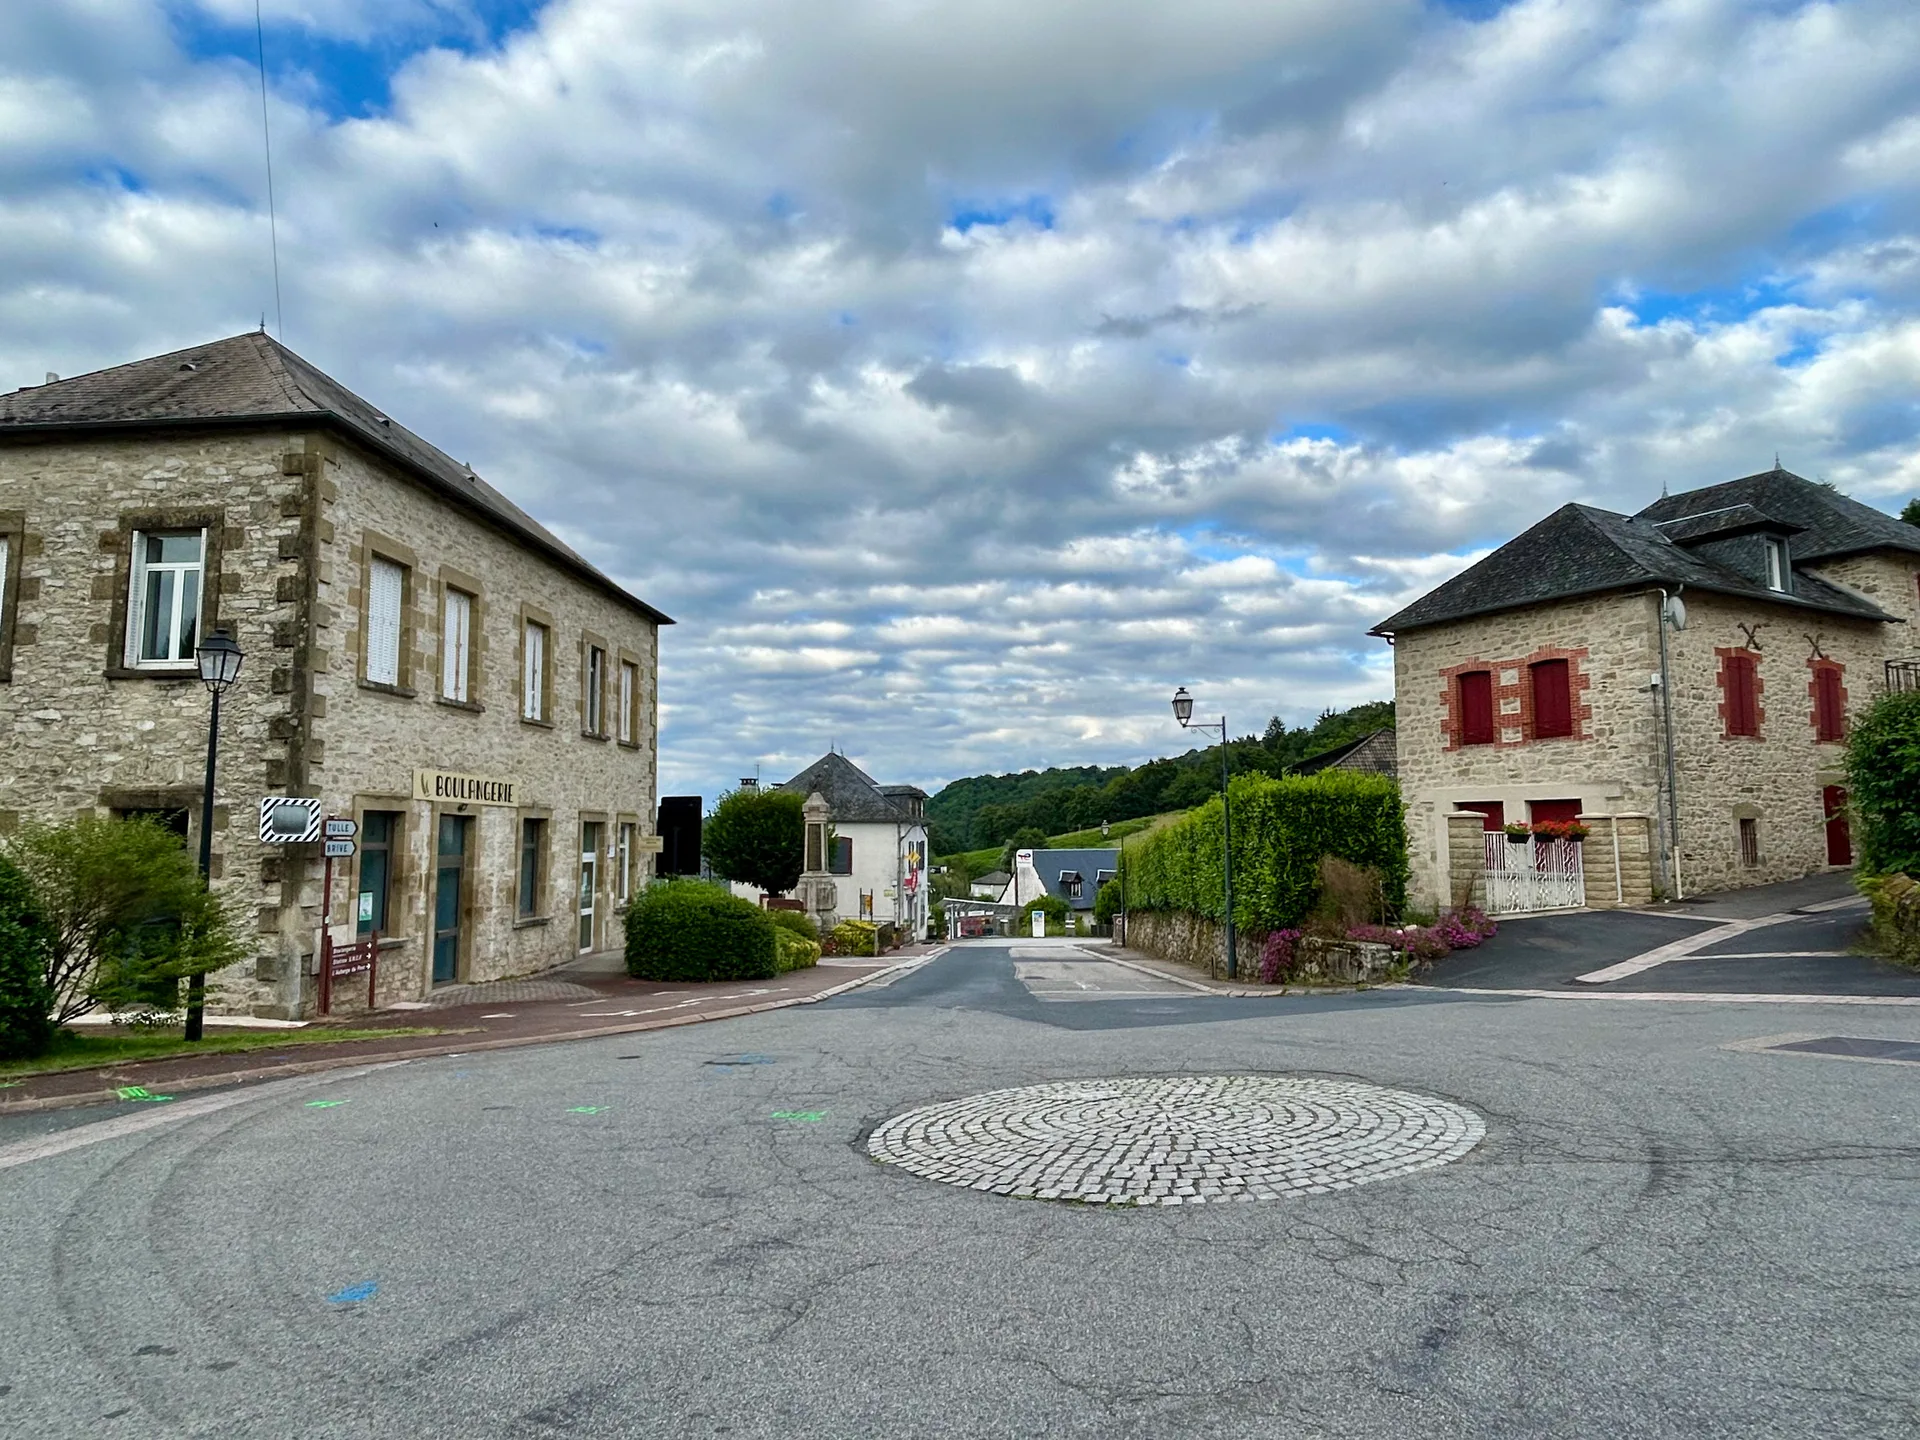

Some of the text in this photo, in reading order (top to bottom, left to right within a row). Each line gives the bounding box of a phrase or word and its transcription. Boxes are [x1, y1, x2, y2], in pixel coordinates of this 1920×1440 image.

[436, 775, 514, 803] BOULANGERIE
[328, 823, 349, 832] TULLE
[327, 844, 348, 853] BRIVE
